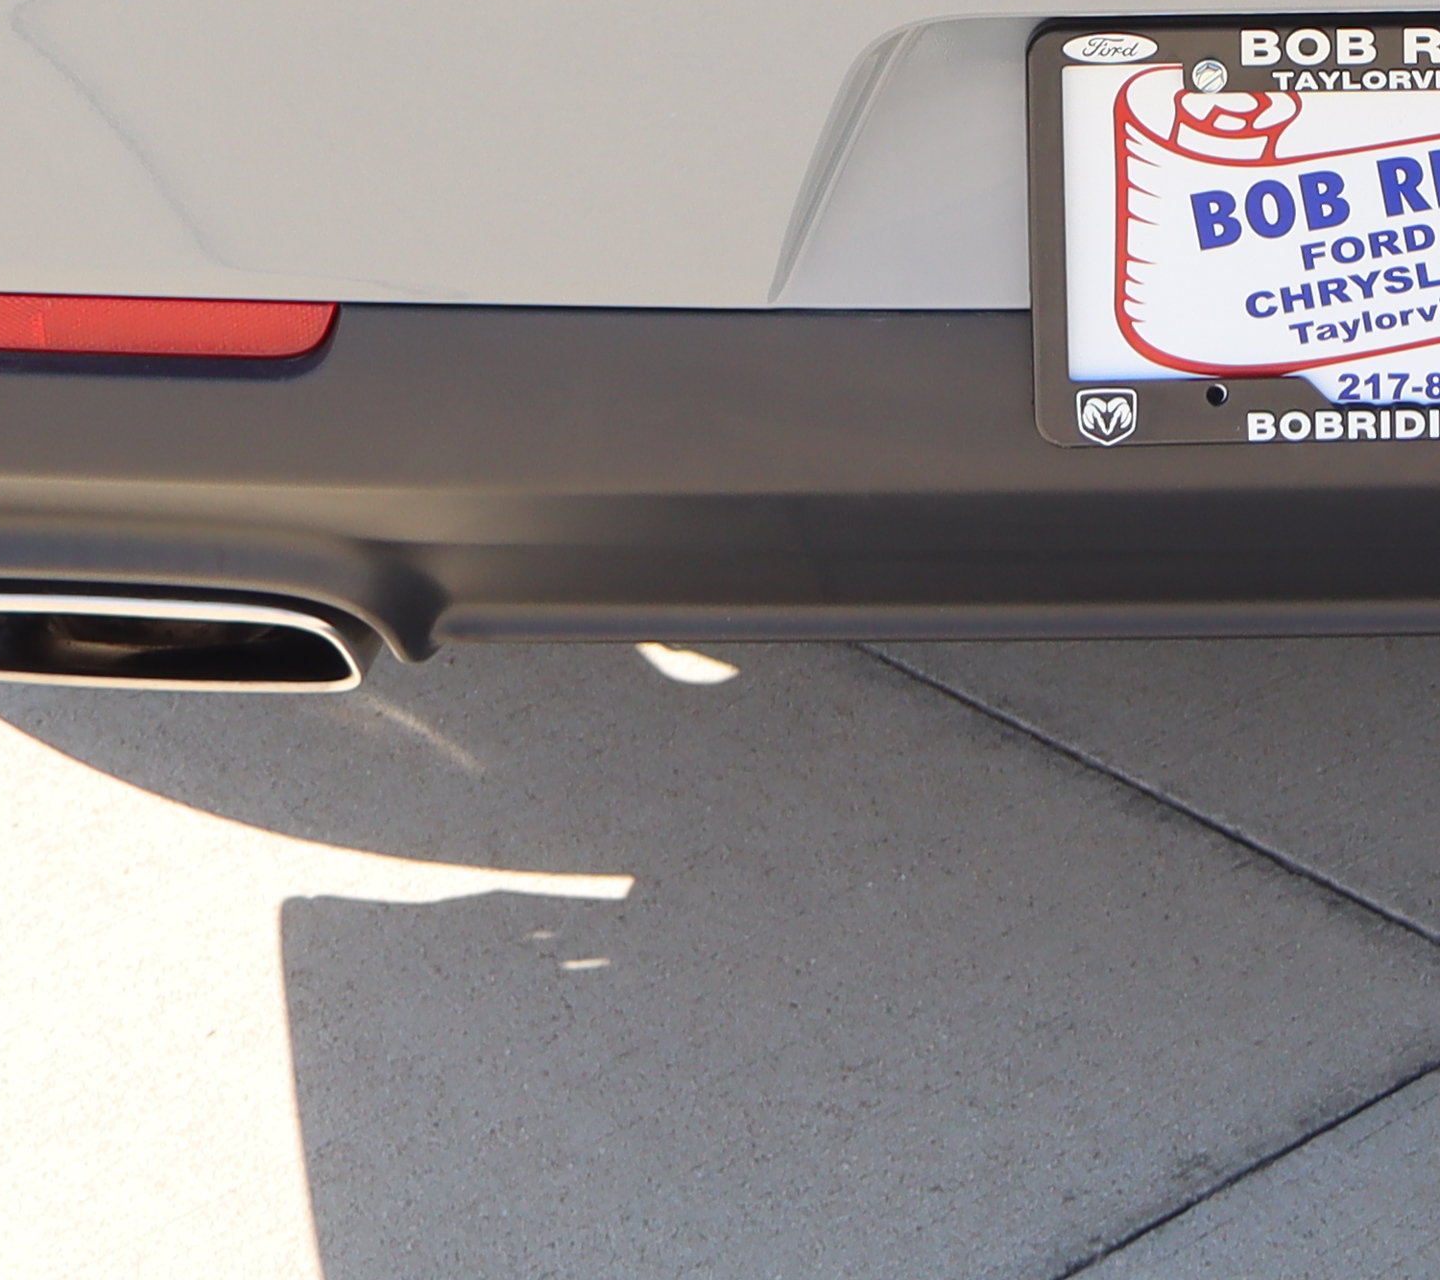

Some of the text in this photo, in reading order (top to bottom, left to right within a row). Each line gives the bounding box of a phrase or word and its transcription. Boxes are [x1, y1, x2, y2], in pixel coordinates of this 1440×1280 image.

[1082, 37, 1139, 58] Ford
[1240, 27, 1378, 67] BOB
[1190, 170, 1351, 251] BOB
[1300, 224, 1436, 271] FORD
